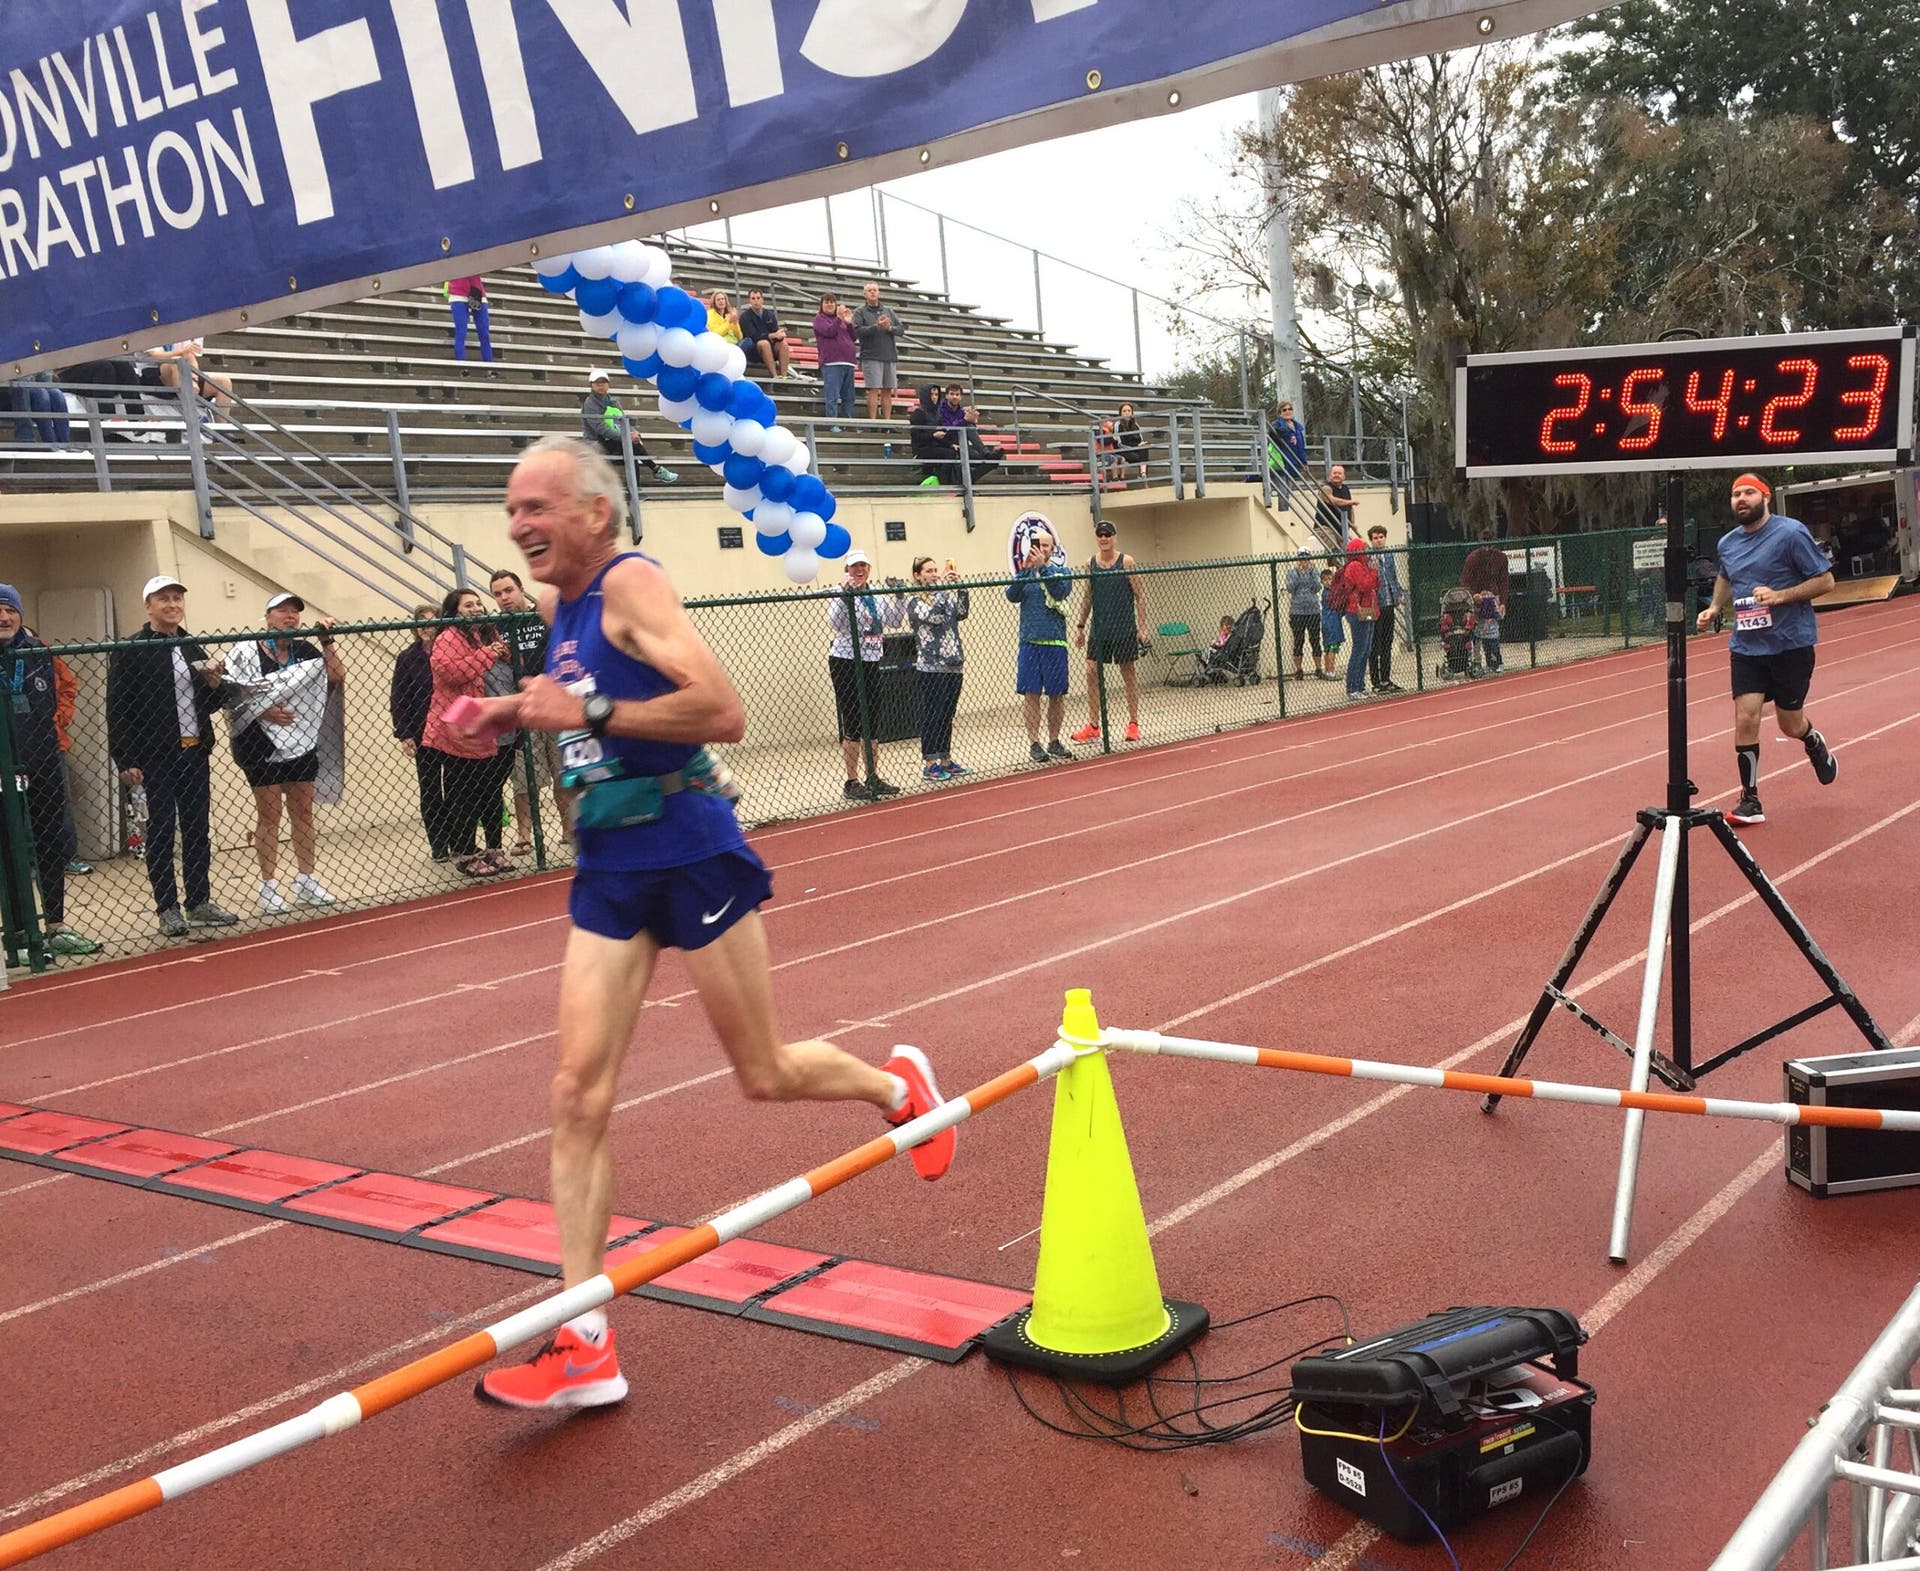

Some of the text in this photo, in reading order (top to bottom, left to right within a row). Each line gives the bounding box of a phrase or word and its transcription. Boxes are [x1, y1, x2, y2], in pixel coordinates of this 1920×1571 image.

[0, 107, 265, 281] RATHON
[250, 0, 1100, 225] FIN
[1740, 617, 1768, 628] 1743
